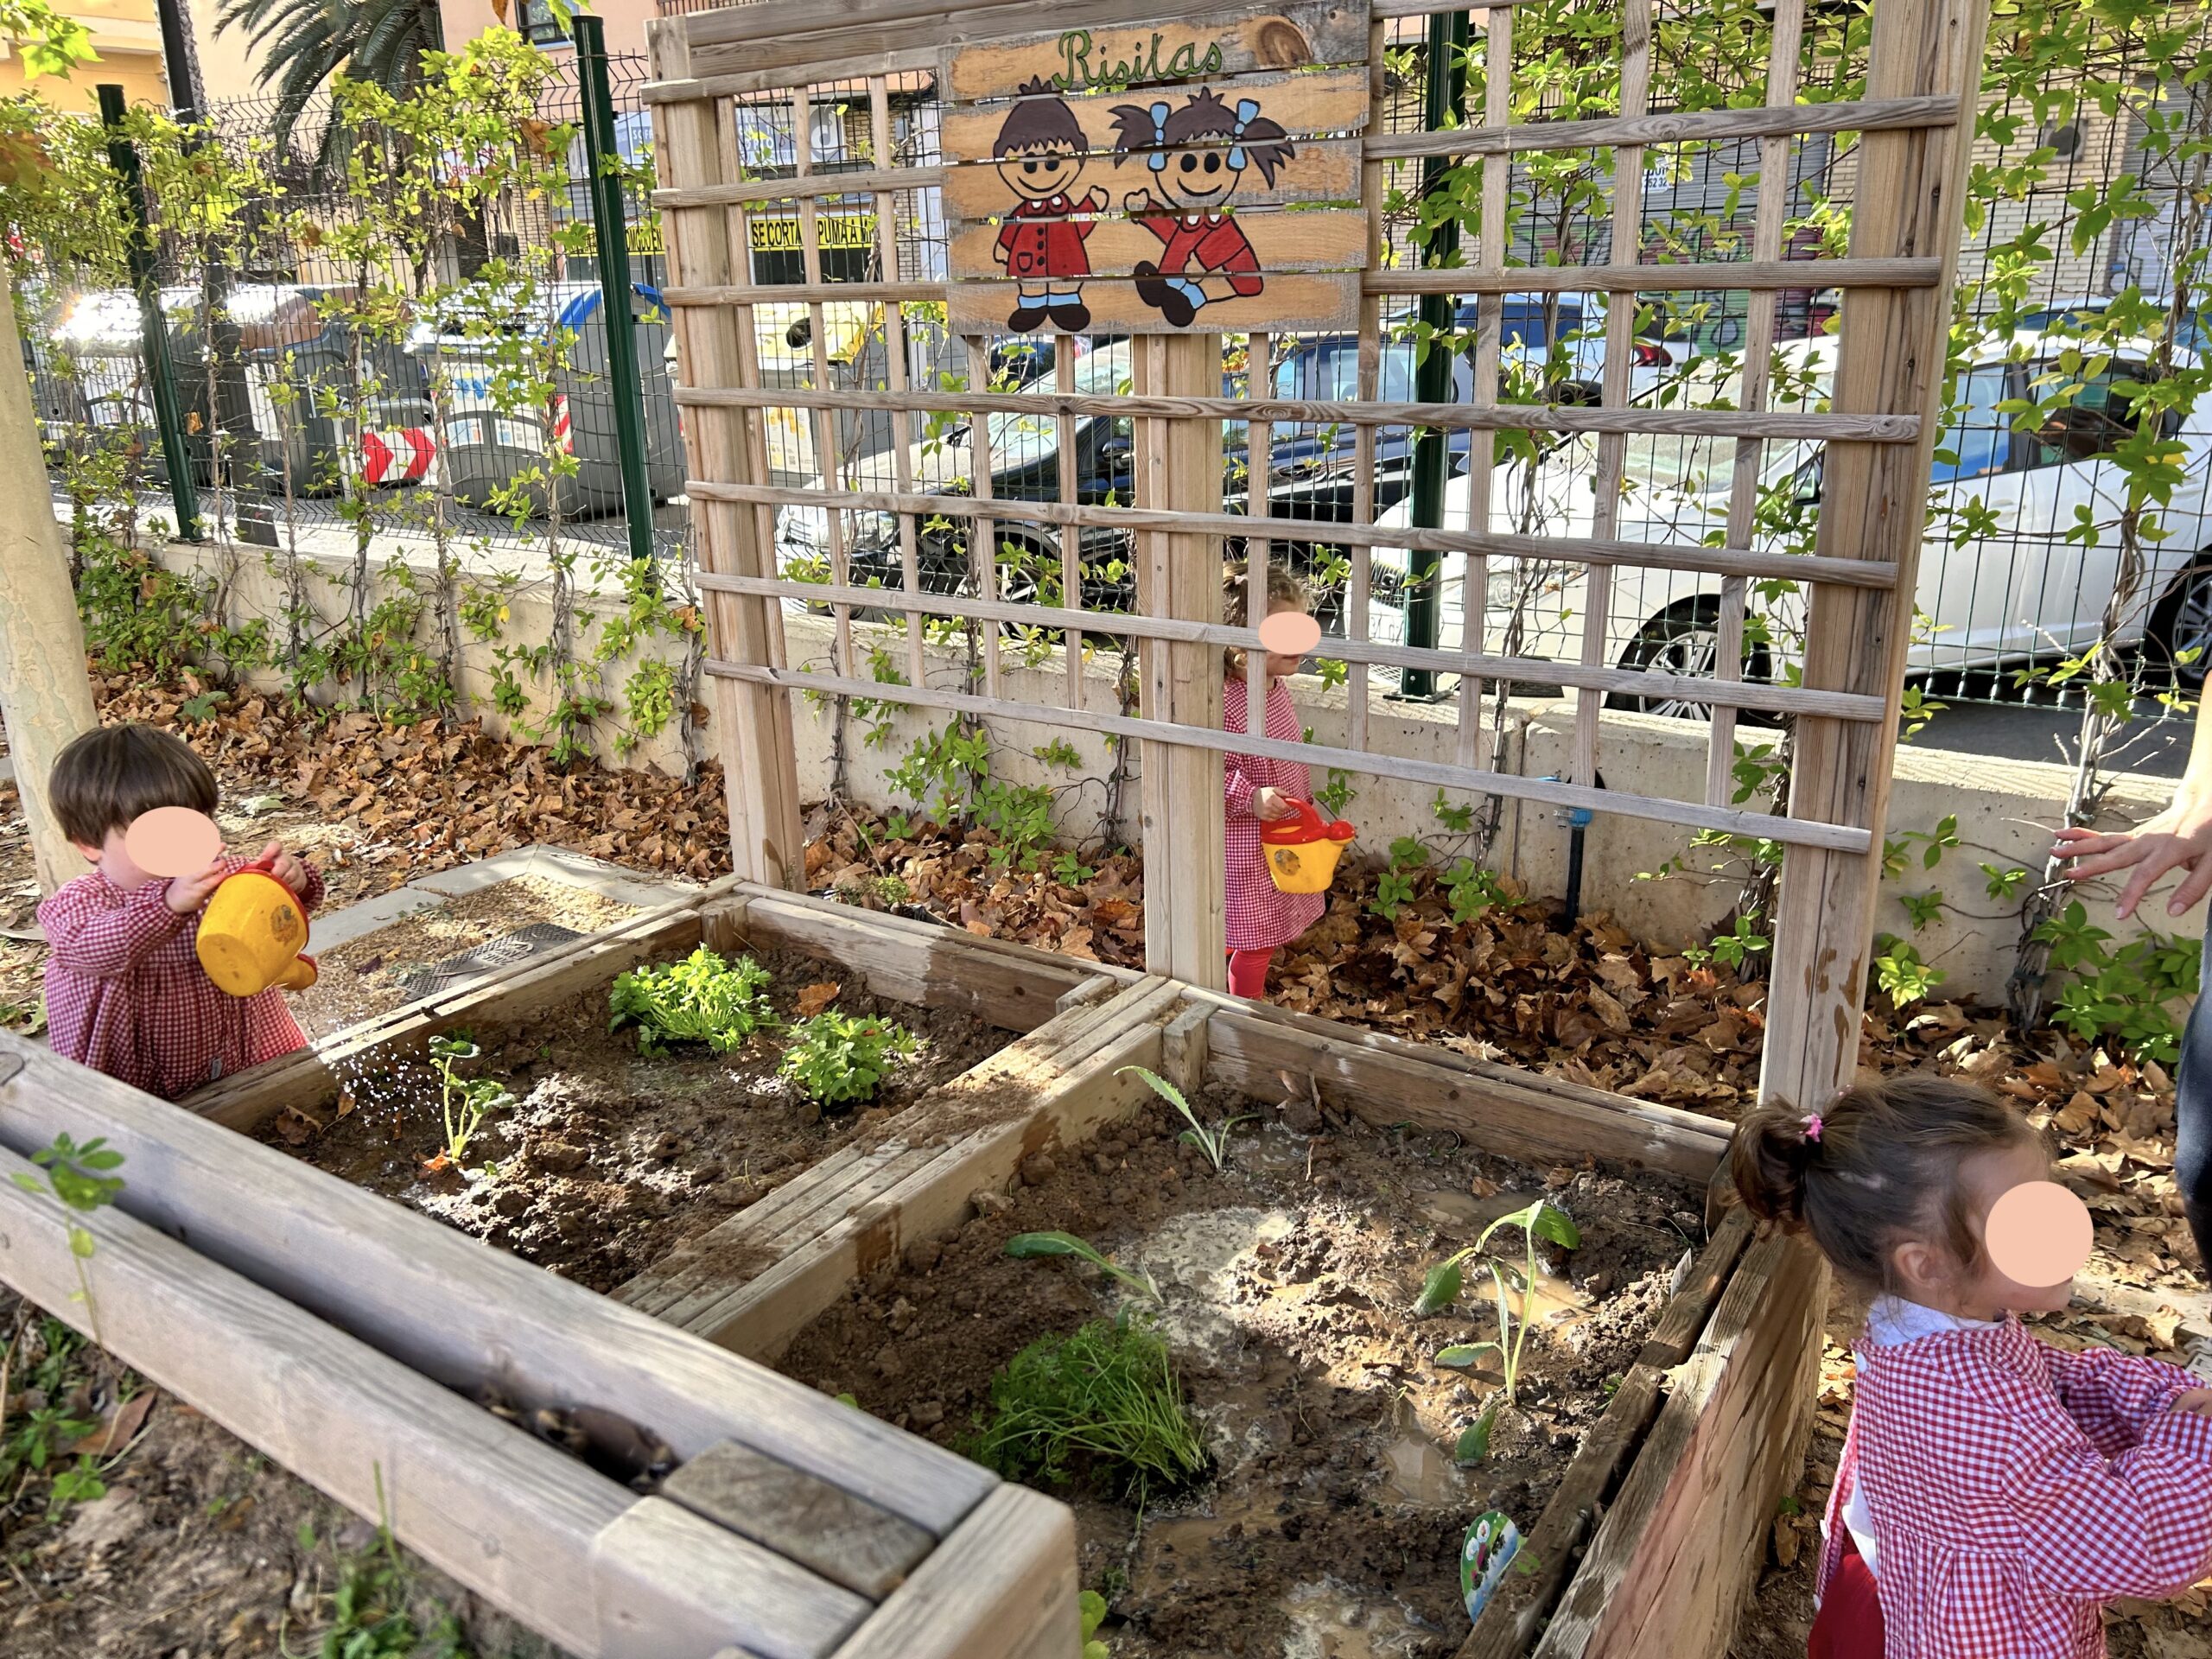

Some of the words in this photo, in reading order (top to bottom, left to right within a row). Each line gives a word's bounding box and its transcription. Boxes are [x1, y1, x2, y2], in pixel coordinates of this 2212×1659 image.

[1052, 29, 1223, 89] Risitas
[753, 222, 766, 246] SE
[817, 219, 848, 245] PUMA
